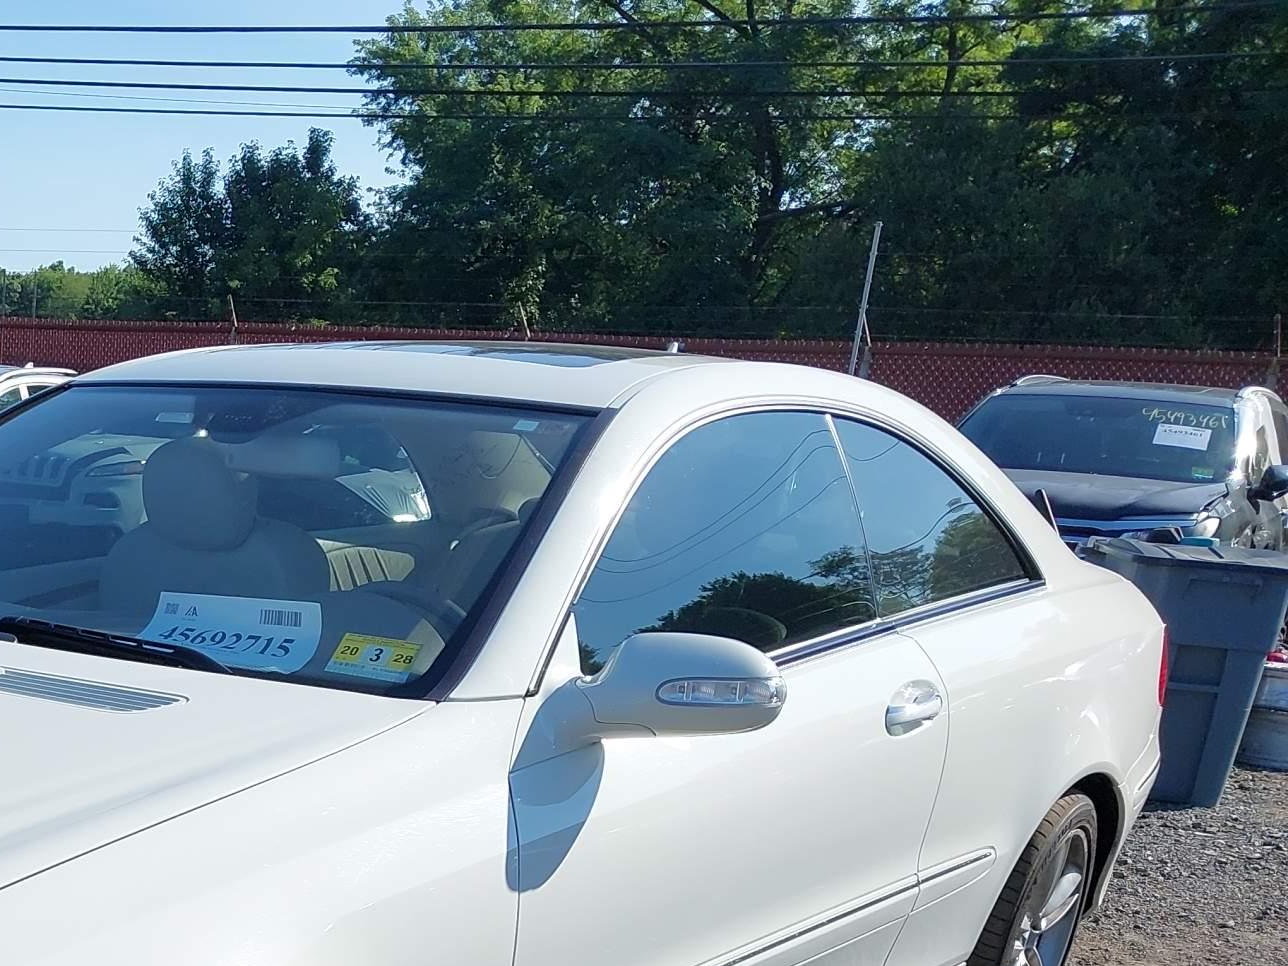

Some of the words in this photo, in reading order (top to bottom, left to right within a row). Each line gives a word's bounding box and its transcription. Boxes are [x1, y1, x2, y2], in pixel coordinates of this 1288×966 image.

[1142, 407, 1229, 429] 45493461
[159, 625, 296, 658] 45692715
[340, 645, 360, 656] 20
[369, 647, 384, 662] 3
[392, 653, 414, 665] 28
